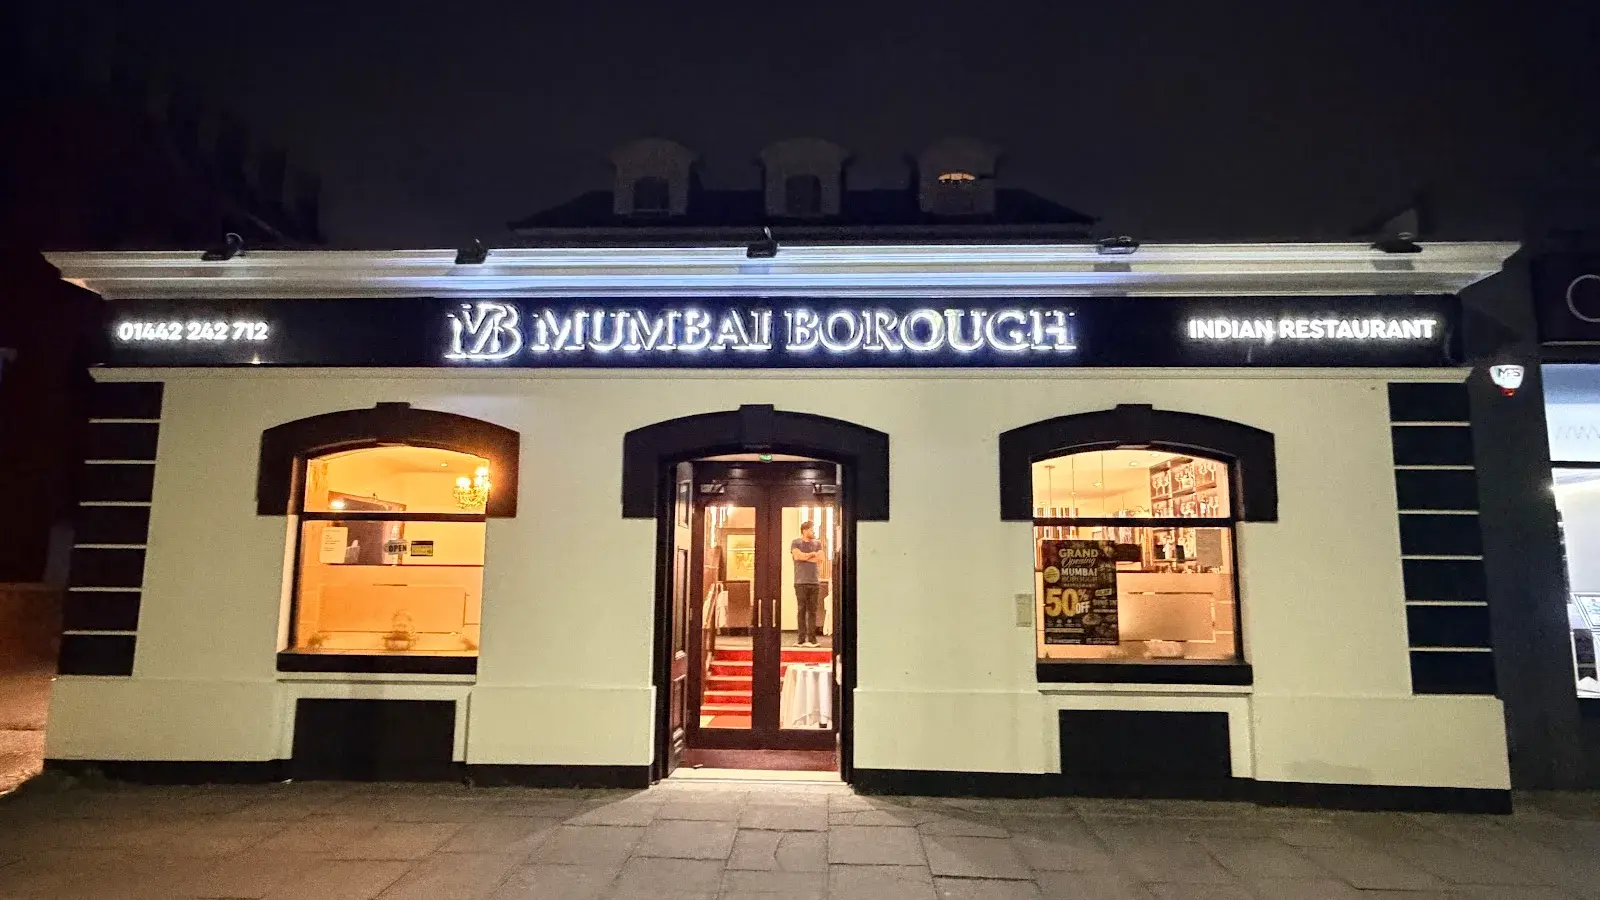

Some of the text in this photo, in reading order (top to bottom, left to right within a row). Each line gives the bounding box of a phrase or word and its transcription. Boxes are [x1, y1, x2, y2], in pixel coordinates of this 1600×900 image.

[118, 321, 269, 340] 01442 242 712
[532, 308, 1077, 352] MUMBAI BOROUGH
[1188, 319, 1437, 340] INDIAN RESTAURANT
[388, 544, 407, 553] OPEN
[1058, 548, 1099, 558] GRAND
[1061, 557, 1096, 567] Opening
[1061, 568, 1097, 576] MUMBAI
[1075, 601, 1090, 614] OFF
